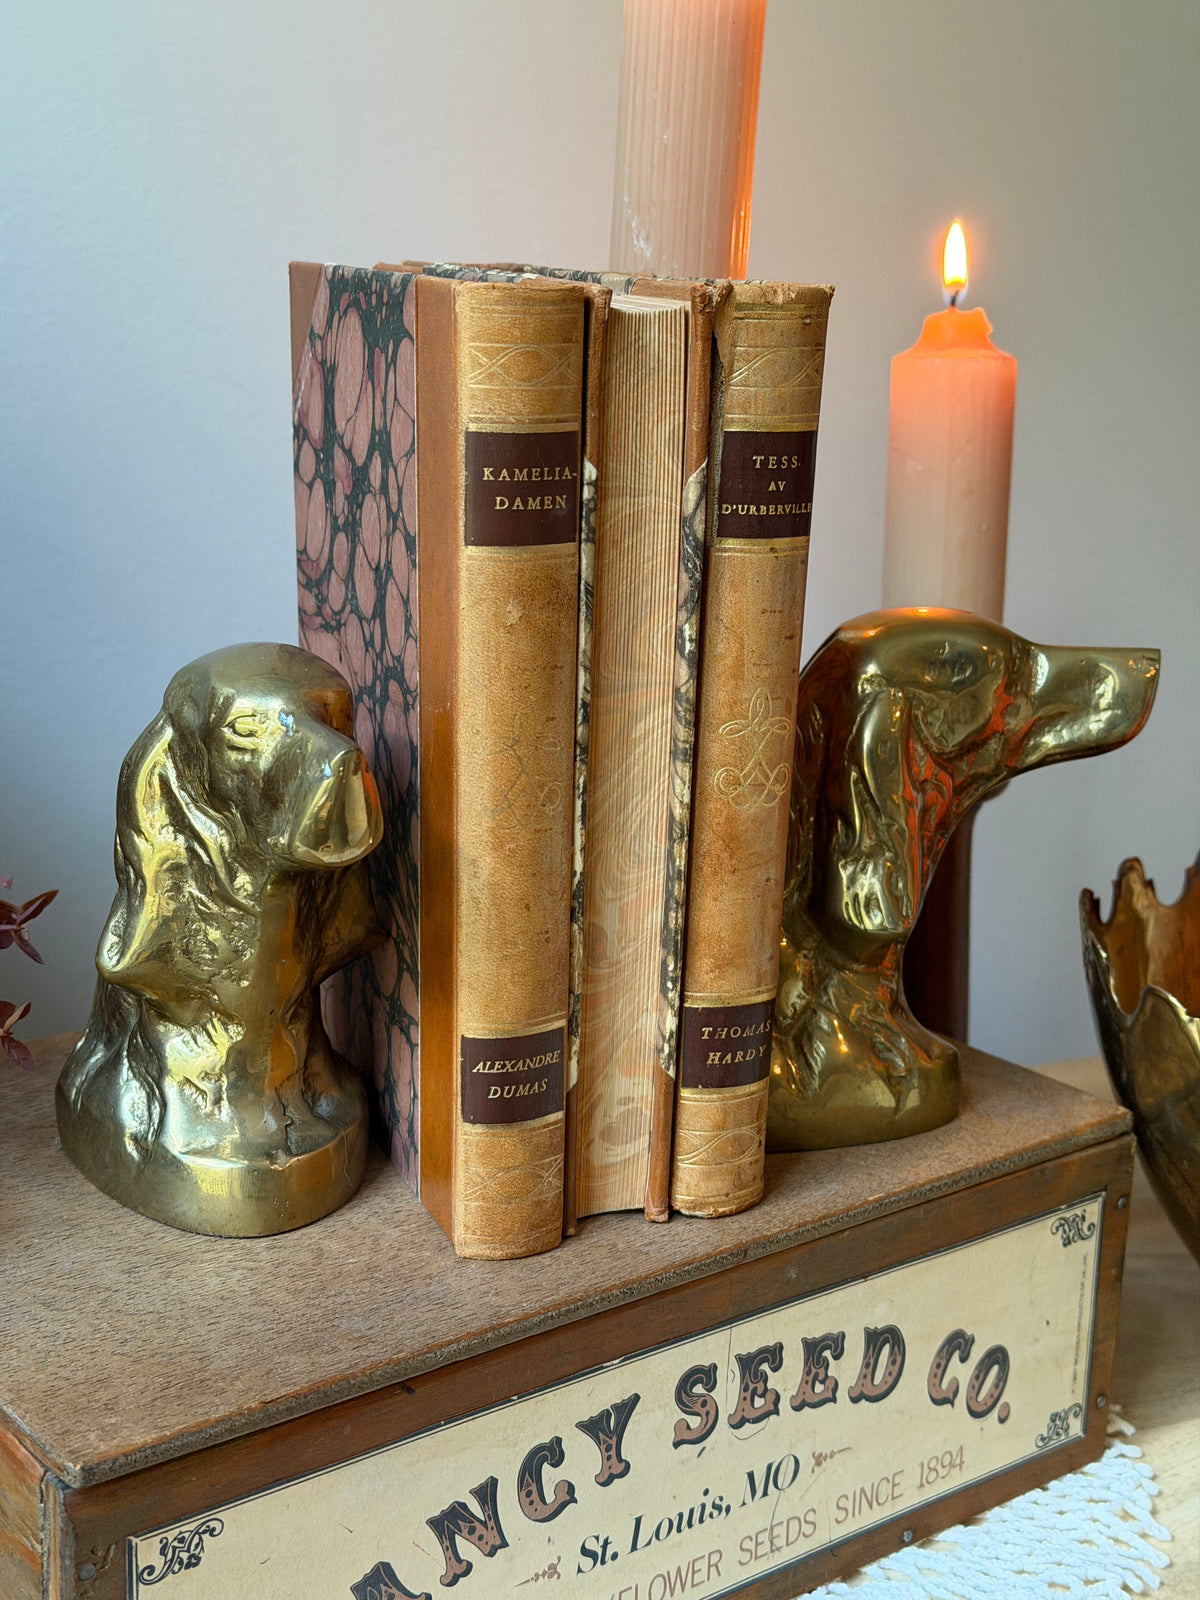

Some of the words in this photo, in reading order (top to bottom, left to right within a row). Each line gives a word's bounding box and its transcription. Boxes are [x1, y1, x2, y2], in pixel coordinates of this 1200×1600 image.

[752, 455, 798, 469] TESS
[482, 466, 577, 481] KAMELIA-
[767, 480, 786, 491] AV
[494, 495, 567, 510] DAMEN
[701, 1019, 772, 1040] THOMAS
[472, 1049, 561, 1074] ALEXANDRE
[706, 1044, 767, 1066] HARDY
[487, 1078, 549, 1099] DUMAS
[672, 1323, 906, 1449] SEED
[926, 1328, 1011, 1424] CO.
[576, 1534, 618, 1576] St.
[626, 1487, 732, 1556] Louis,
[738, 1454, 800, 1507] MO
[737, 1508, 817, 1566] SEEDS
[834, 1469, 904, 1525] SINCE
[916, 1445, 965, 1489] 1894
